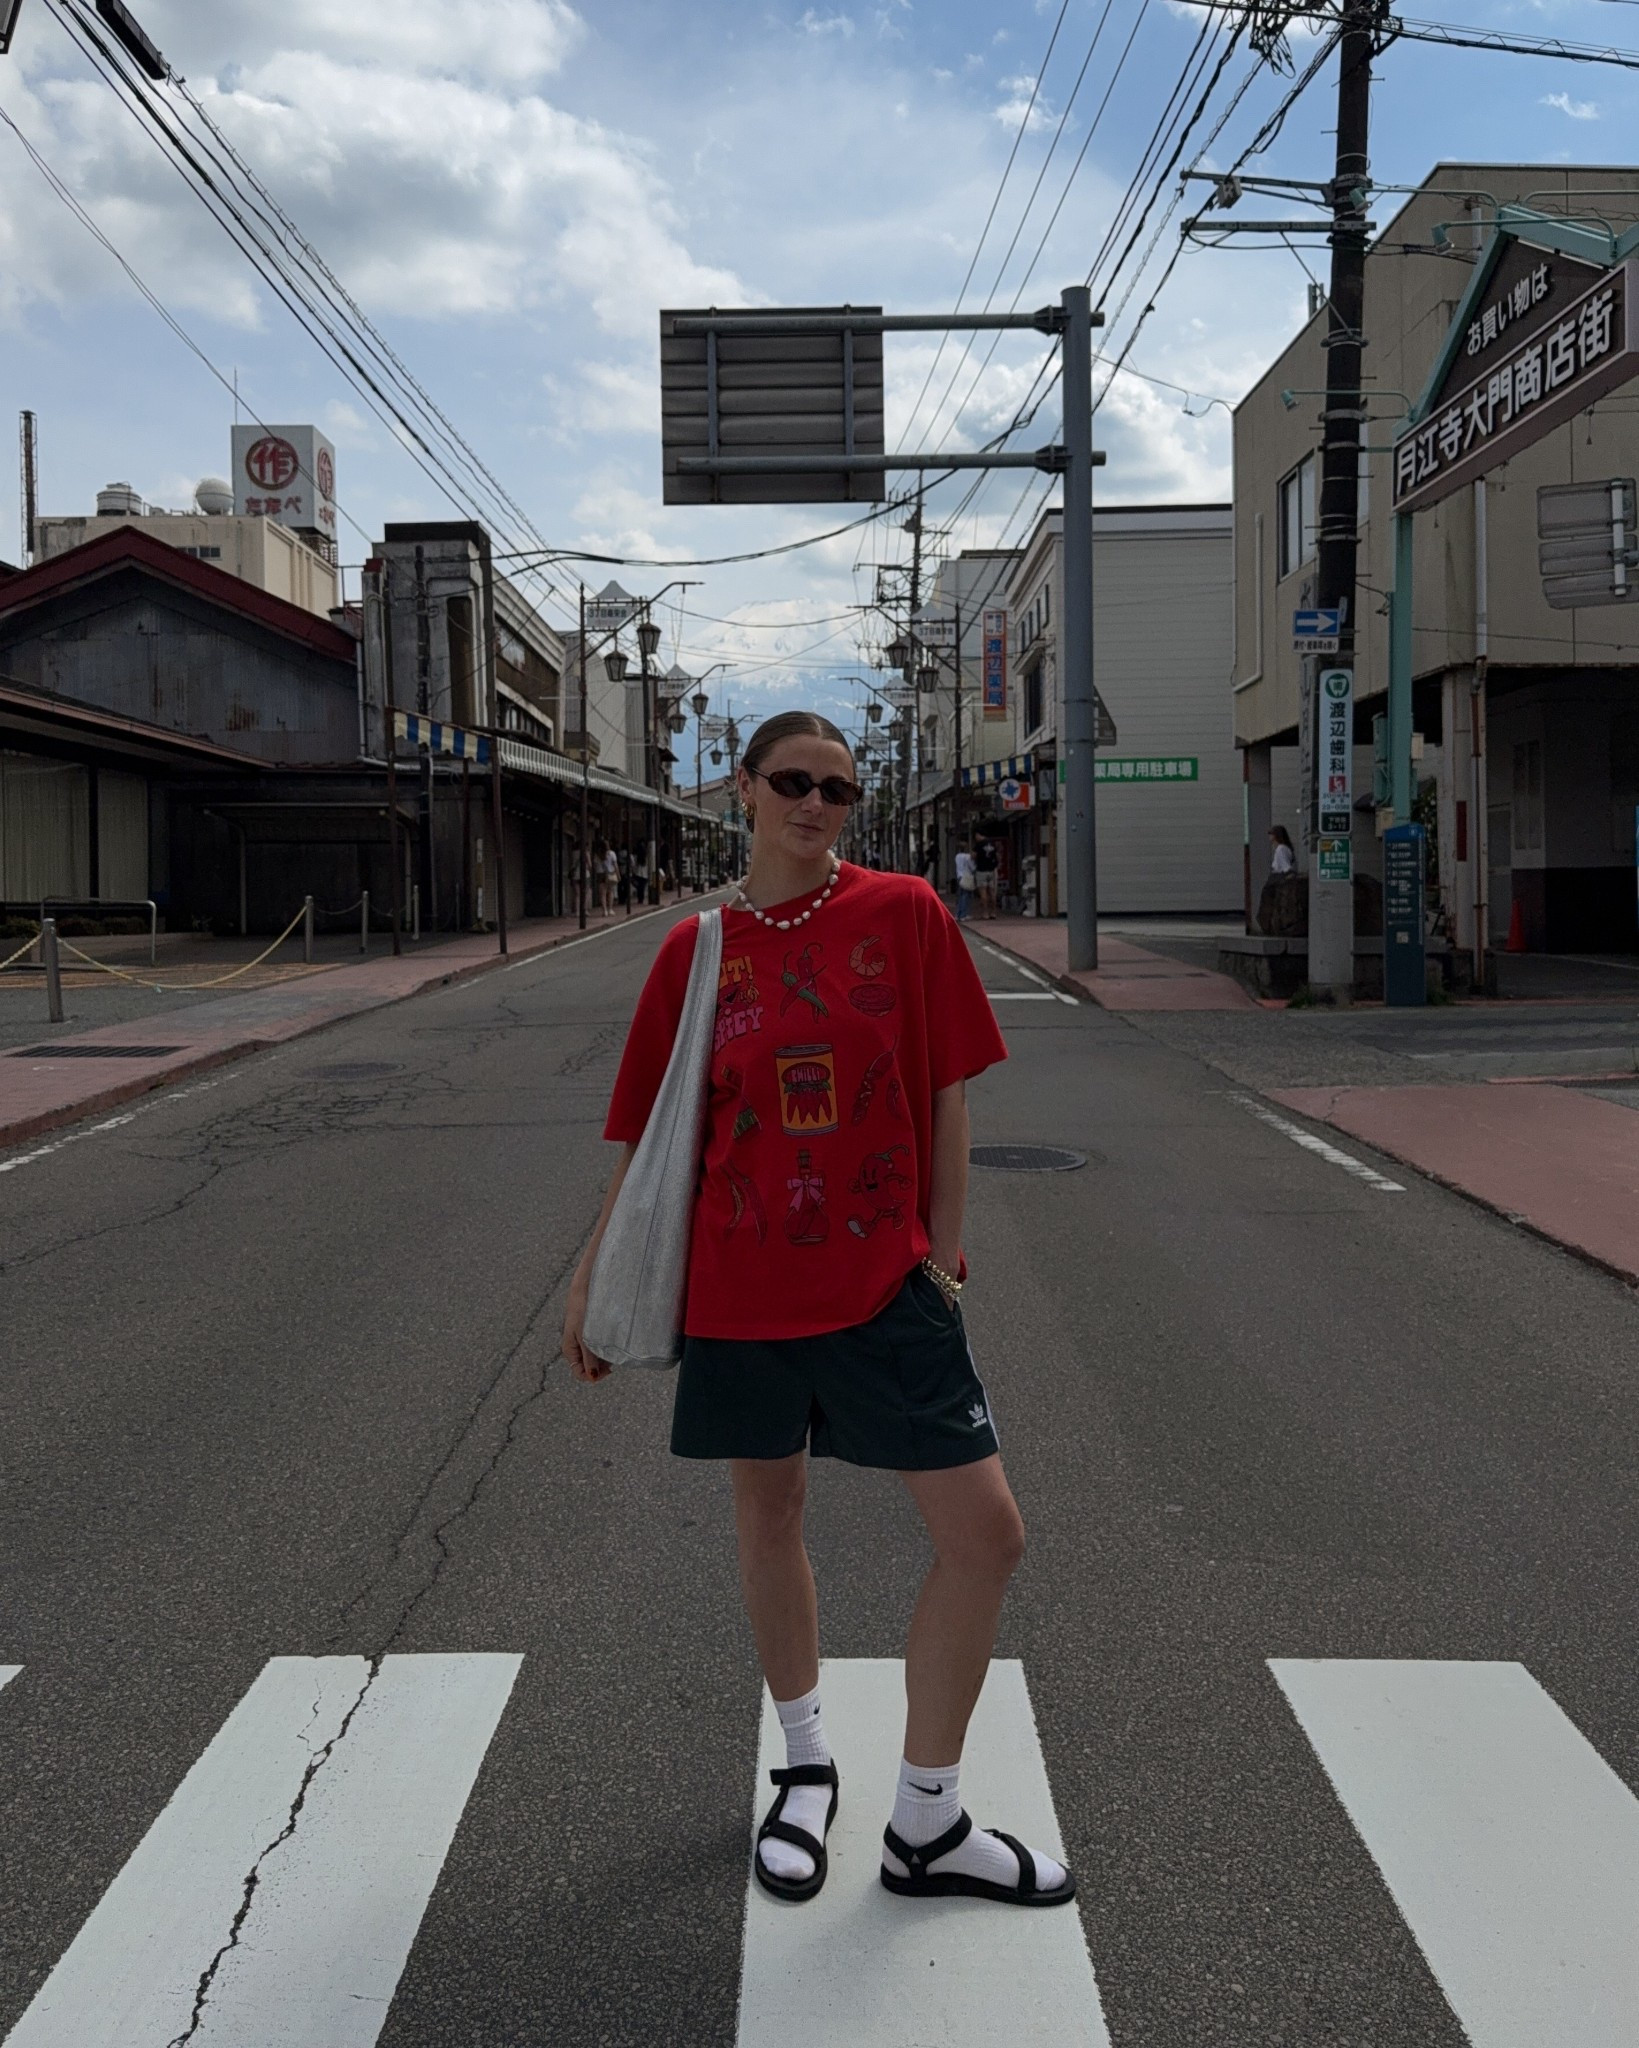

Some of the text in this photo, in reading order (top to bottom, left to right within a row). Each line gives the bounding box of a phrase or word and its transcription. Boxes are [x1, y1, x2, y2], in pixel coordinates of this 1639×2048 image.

[1466, 262, 1549, 356] お買い物は
[1396, 288, 1614, 496] 月江寺大門商店街
[245, 496, 302, 515] たなべ
[1094, 761, 1192, 777] 薬局専用駐車場
[1329, 702, 1346, 774] 渡辺歯科
